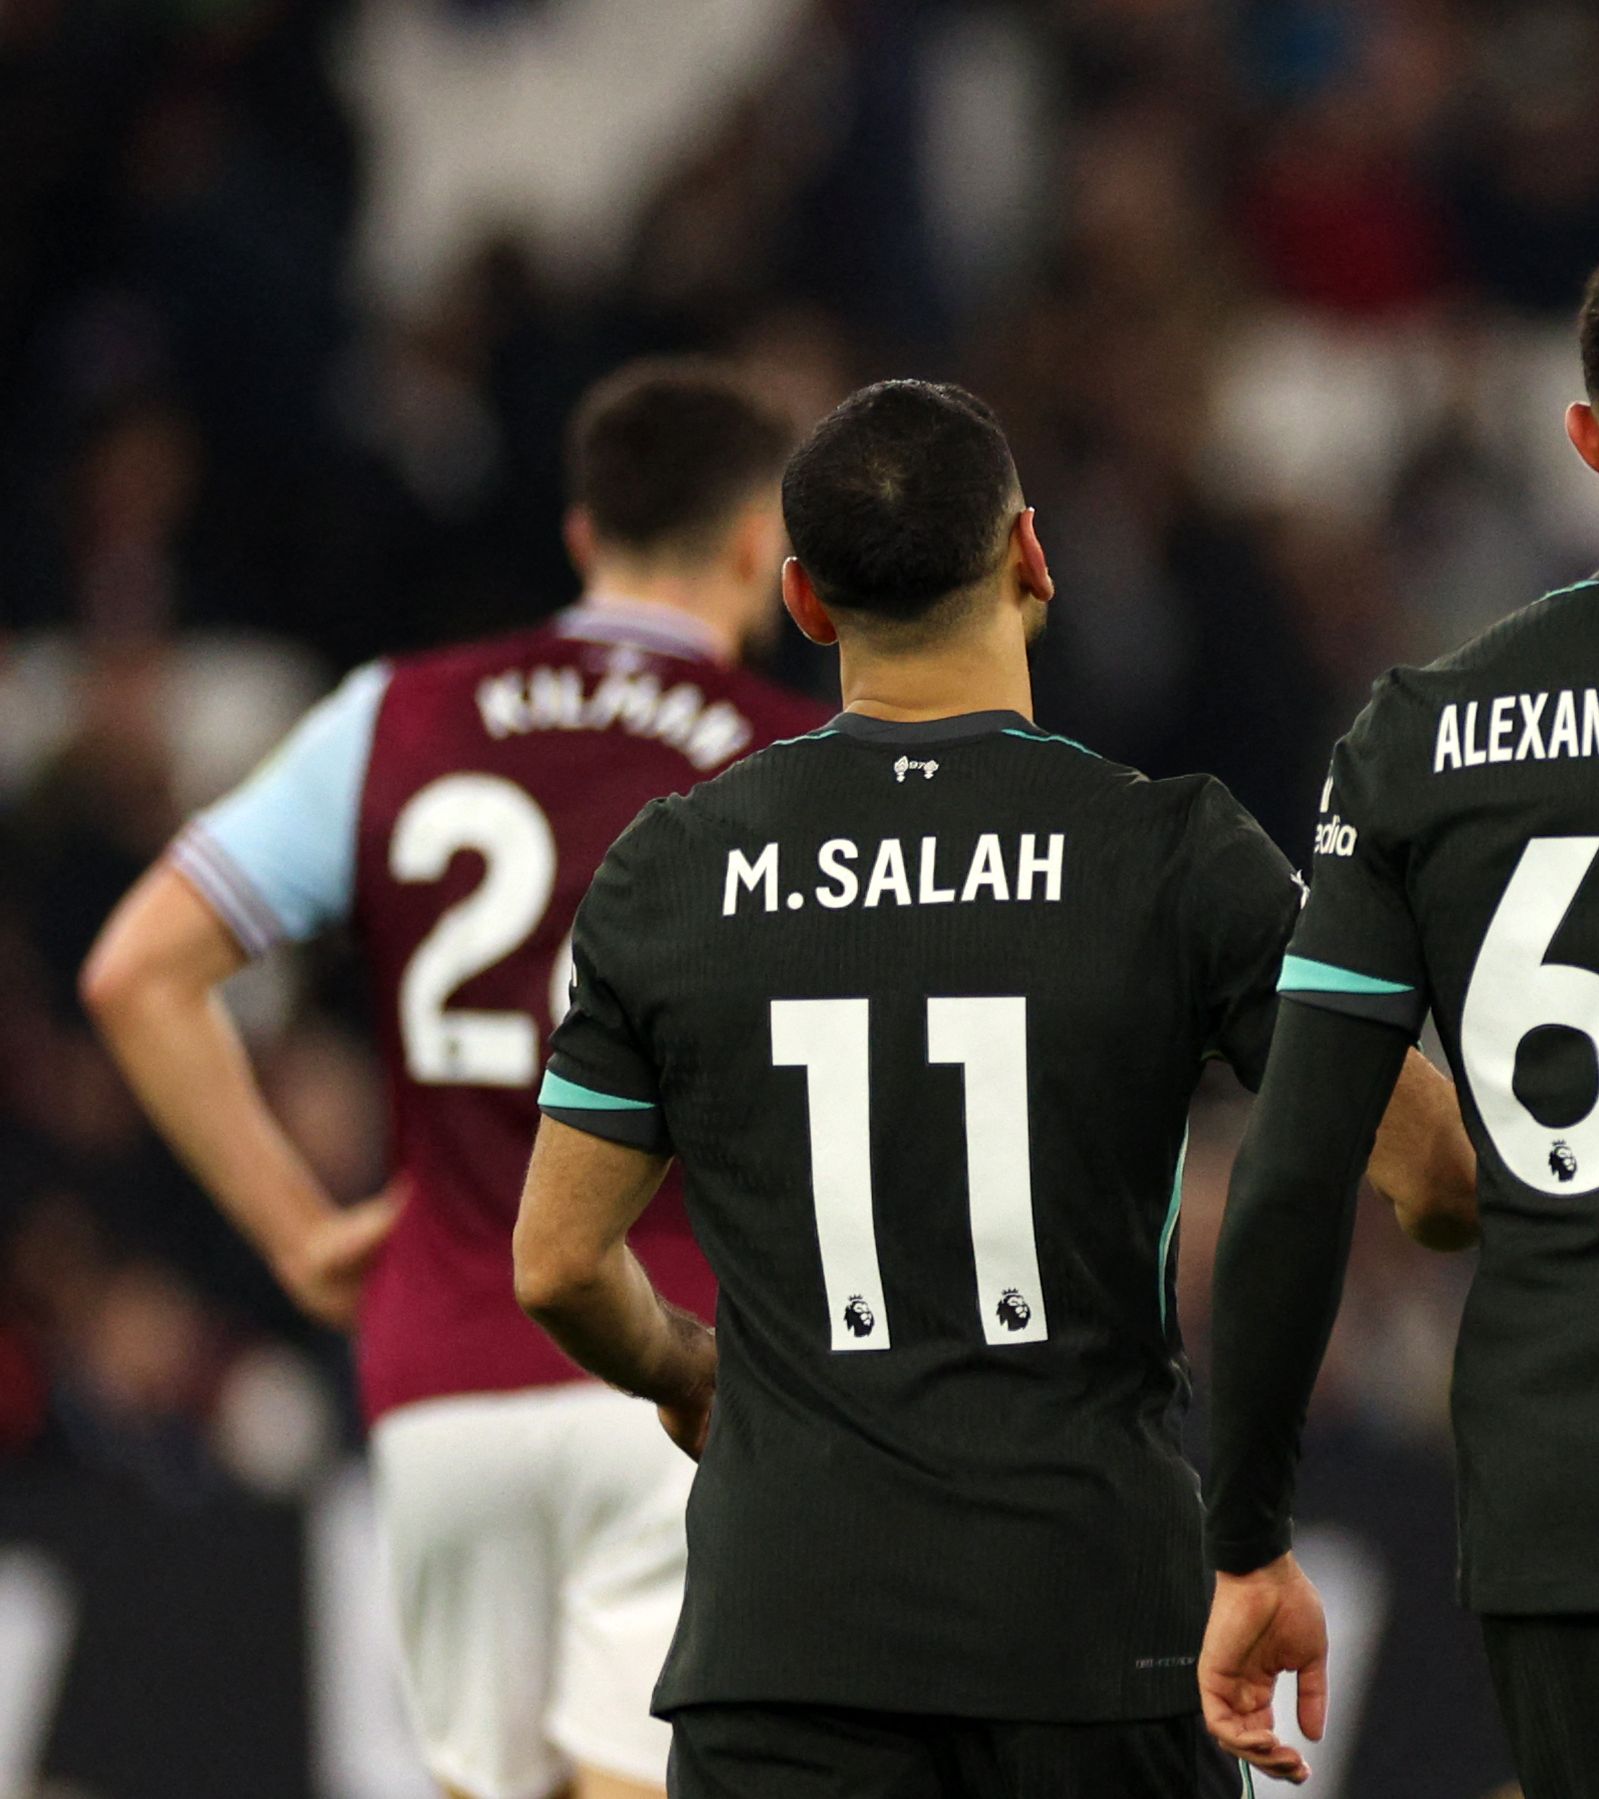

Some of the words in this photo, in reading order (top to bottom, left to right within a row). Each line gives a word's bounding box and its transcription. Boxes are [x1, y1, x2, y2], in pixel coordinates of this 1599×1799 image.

[475, 663, 753, 771] KILMAN
[388, 771, 573, 1088] 2
[722, 833, 1065, 916] M.SALAH
[770, 996, 1049, 1352] 11
